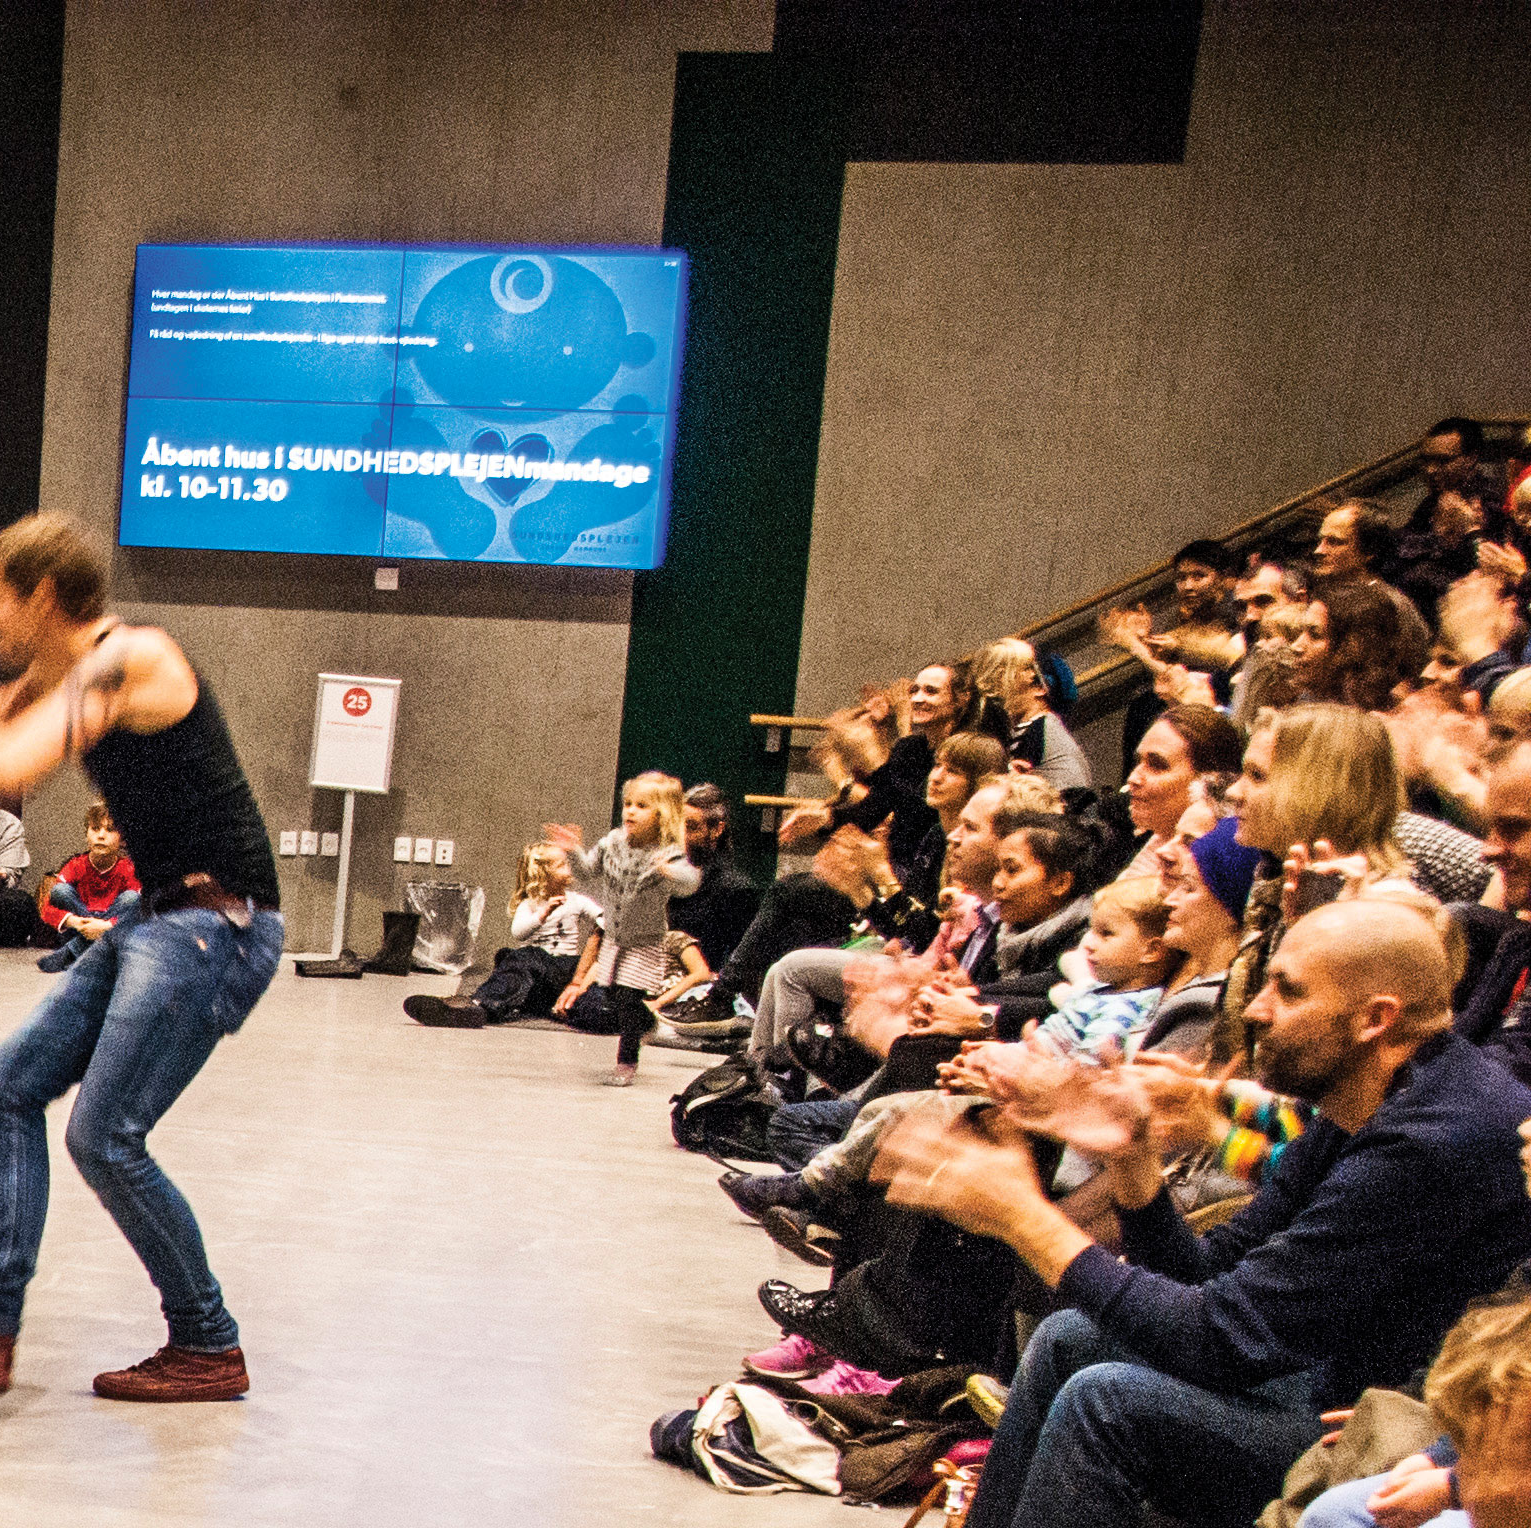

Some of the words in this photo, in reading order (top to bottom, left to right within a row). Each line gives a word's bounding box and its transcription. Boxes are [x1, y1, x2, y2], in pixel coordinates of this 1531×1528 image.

[141, 437, 220, 467] Åbent
[224, 445, 270, 470] hus
[274, 446, 285, 470] i
[287, 447, 651, 488] SUNDHEDSPLEJENmandage
[140, 475, 171, 498] kl.
[178, 476, 288, 502] 10-11.30
[346, 694, 368, 710] 25
